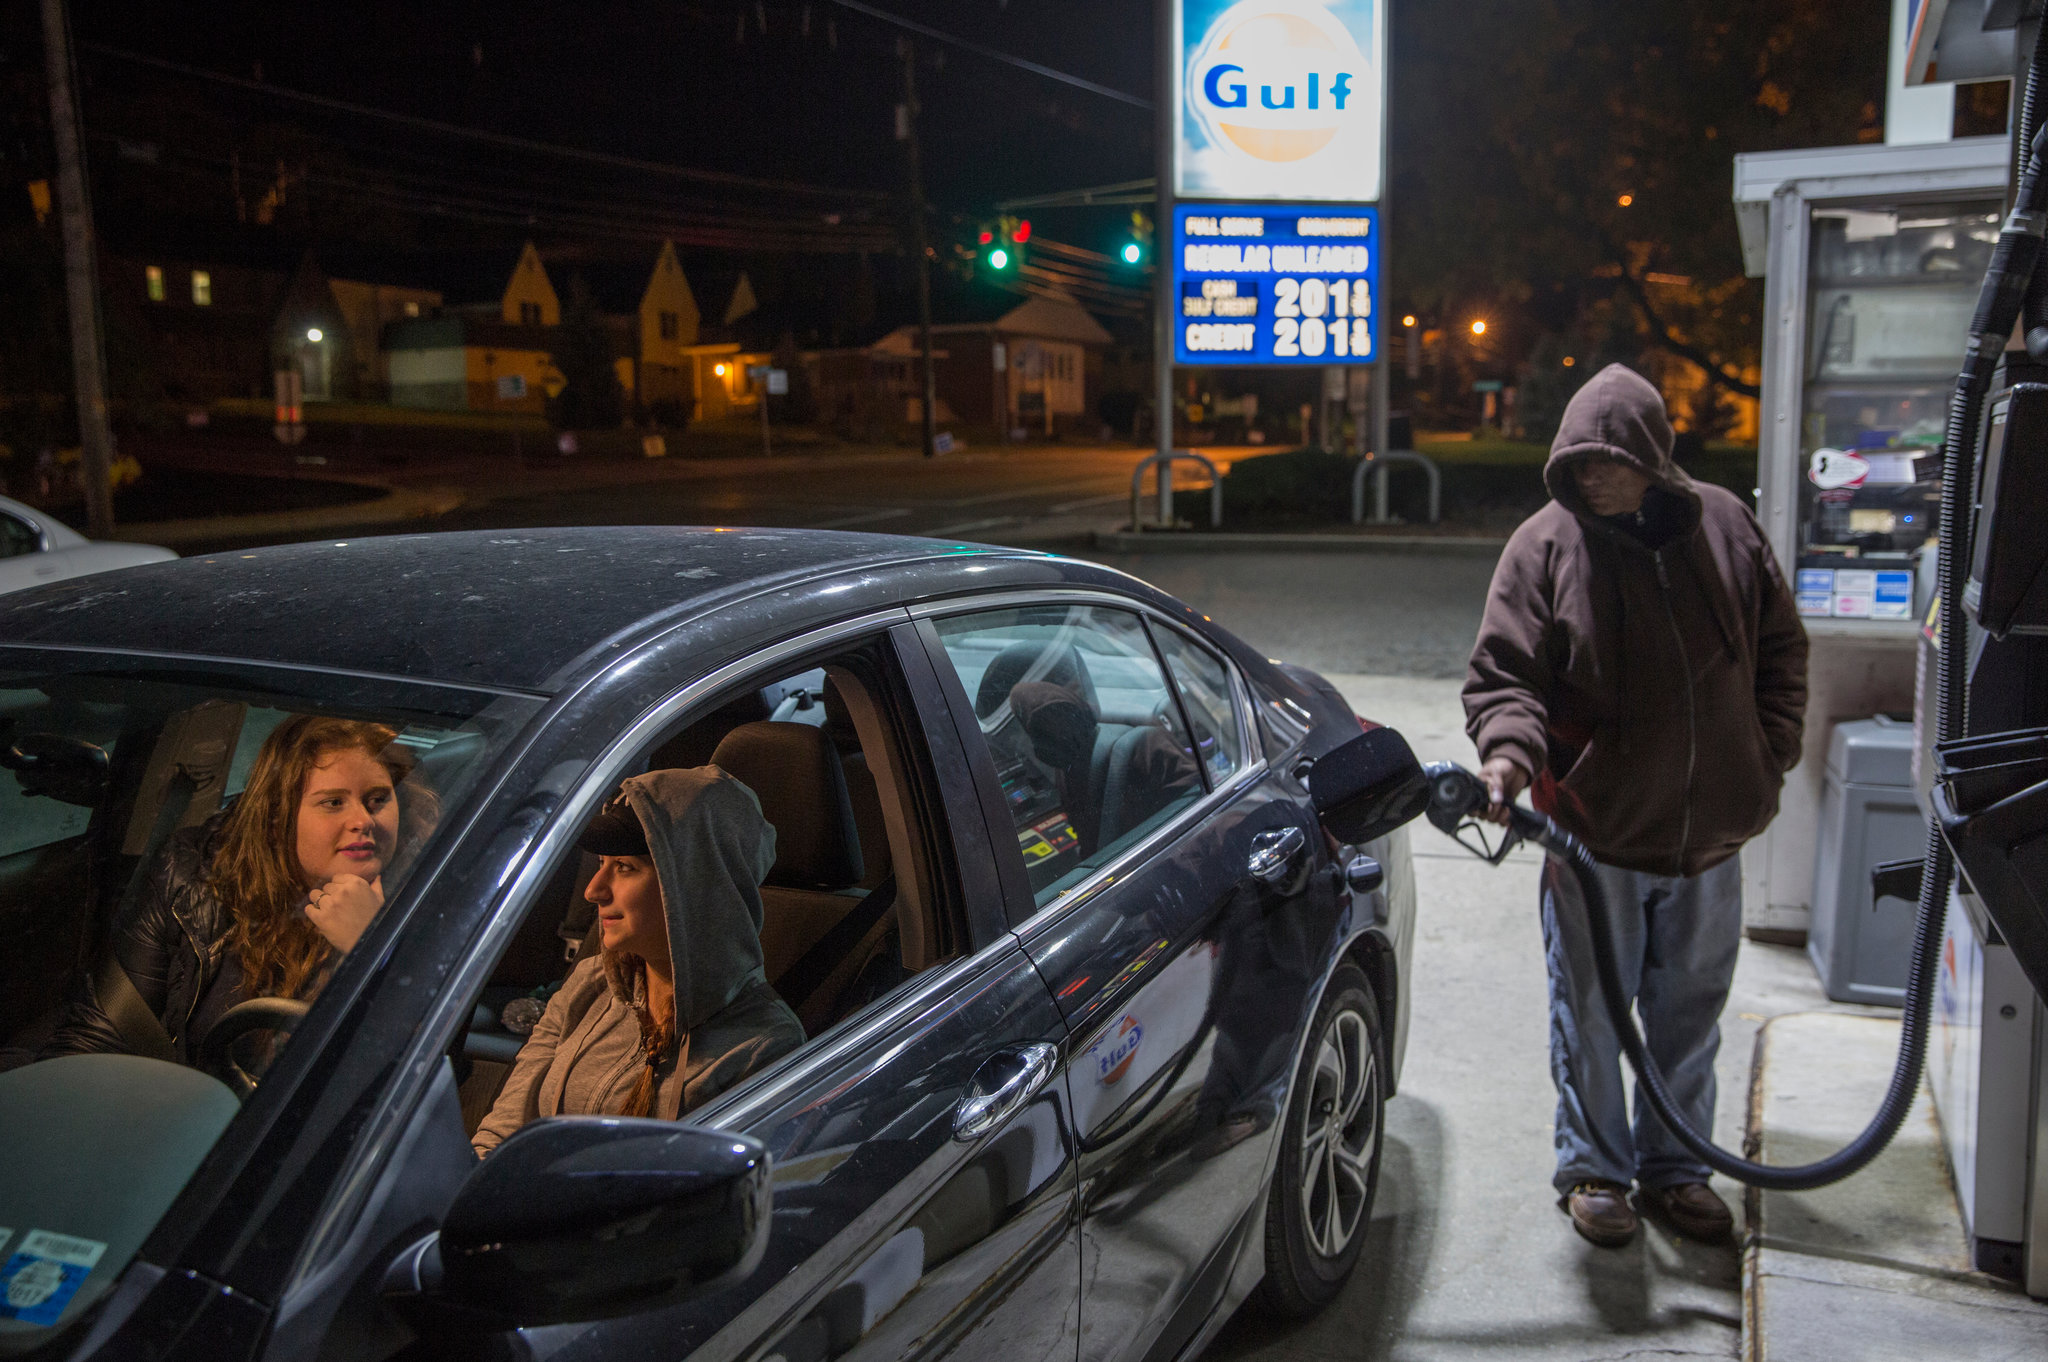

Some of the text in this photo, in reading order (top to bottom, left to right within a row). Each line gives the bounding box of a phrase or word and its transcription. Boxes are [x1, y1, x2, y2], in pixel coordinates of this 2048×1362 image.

[1204, 63, 1353, 111] Gulf
[1184, 244, 1369, 273] REGULAR UNLEADED
[1186, 323, 1256, 351] CREDIT
